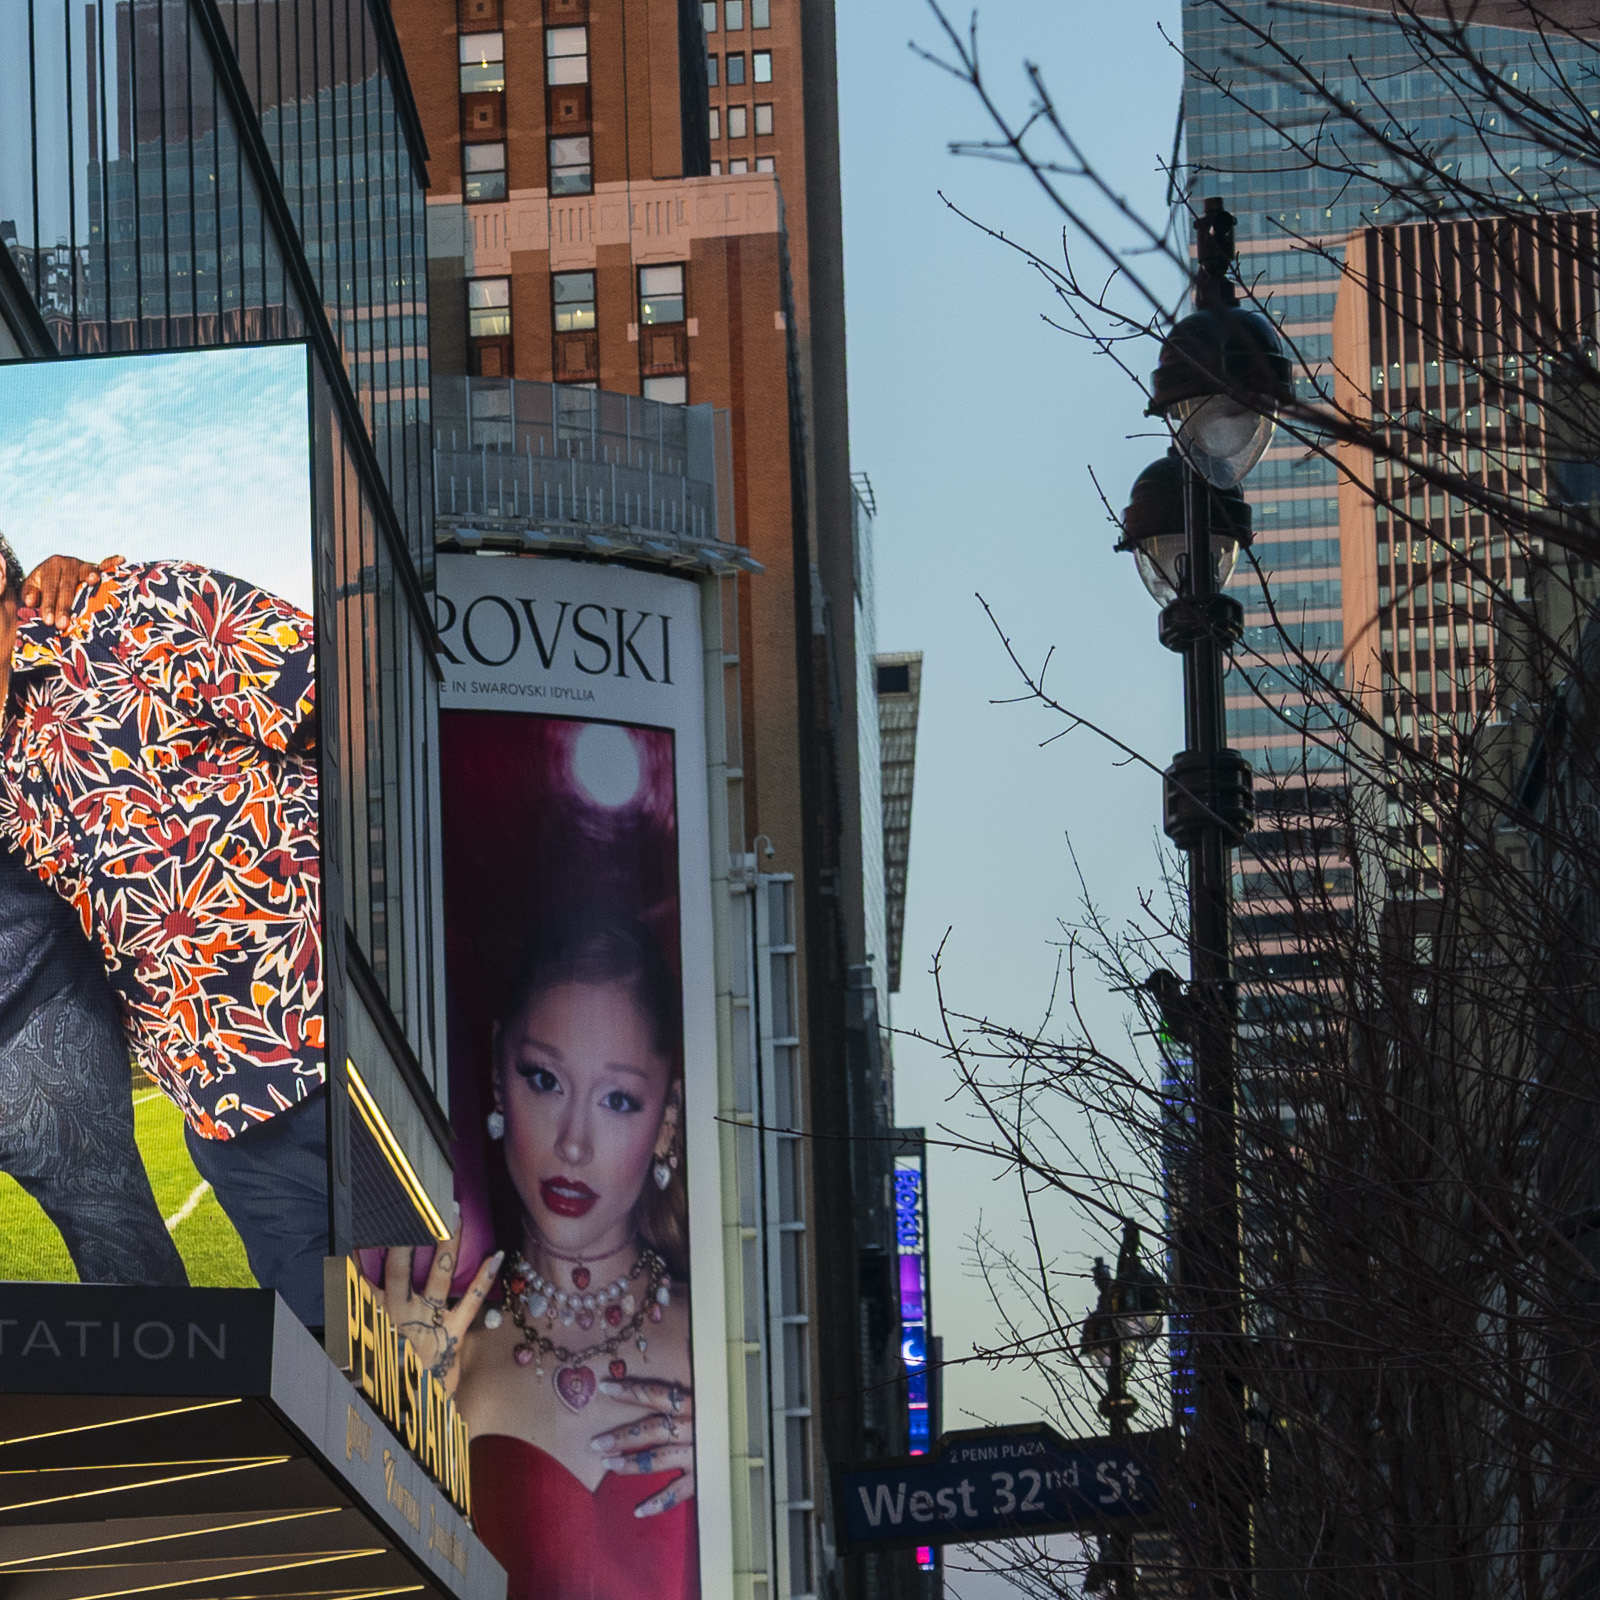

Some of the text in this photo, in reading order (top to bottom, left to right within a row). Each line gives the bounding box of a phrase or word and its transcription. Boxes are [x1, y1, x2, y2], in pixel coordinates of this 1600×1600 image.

[452, 682, 467, 693] IN
[471, 682, 547, 698] SWAROVSKI
[550, 687, 596, 702] IDYLLIA
[346, 1255, 401, 1433] PENN
[403, 1338, 472, 1517] STATION
[950, 1442, 1047, 1463] 2 PENN PLAZA
[858, 1460, 1143, 1527] West 32nd St
